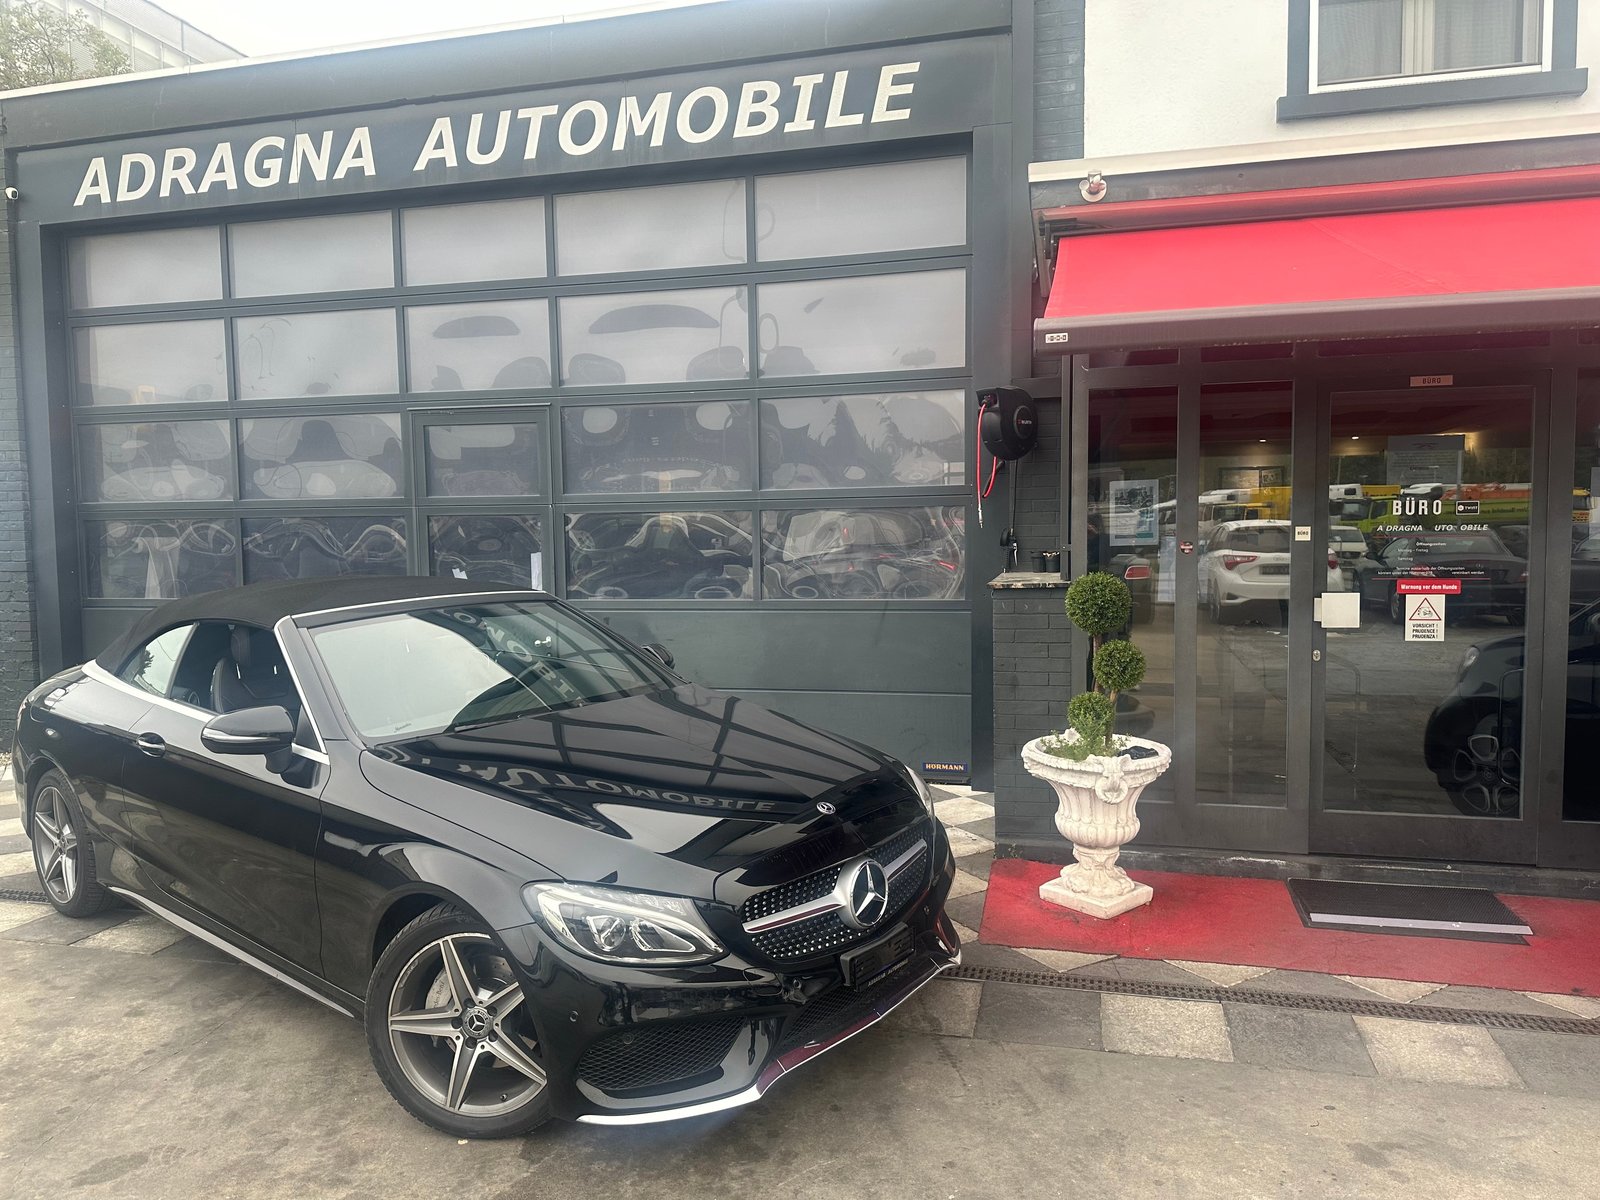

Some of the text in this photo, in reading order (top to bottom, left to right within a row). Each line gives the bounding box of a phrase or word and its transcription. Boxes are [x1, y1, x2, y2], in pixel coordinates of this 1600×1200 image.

[73, 61, 920, 207] ADRAGNA AUTOMOBILE
[1422, 377, 1441, 385] BÜRO
[1393, 498, 1442, 515] BÜRO
